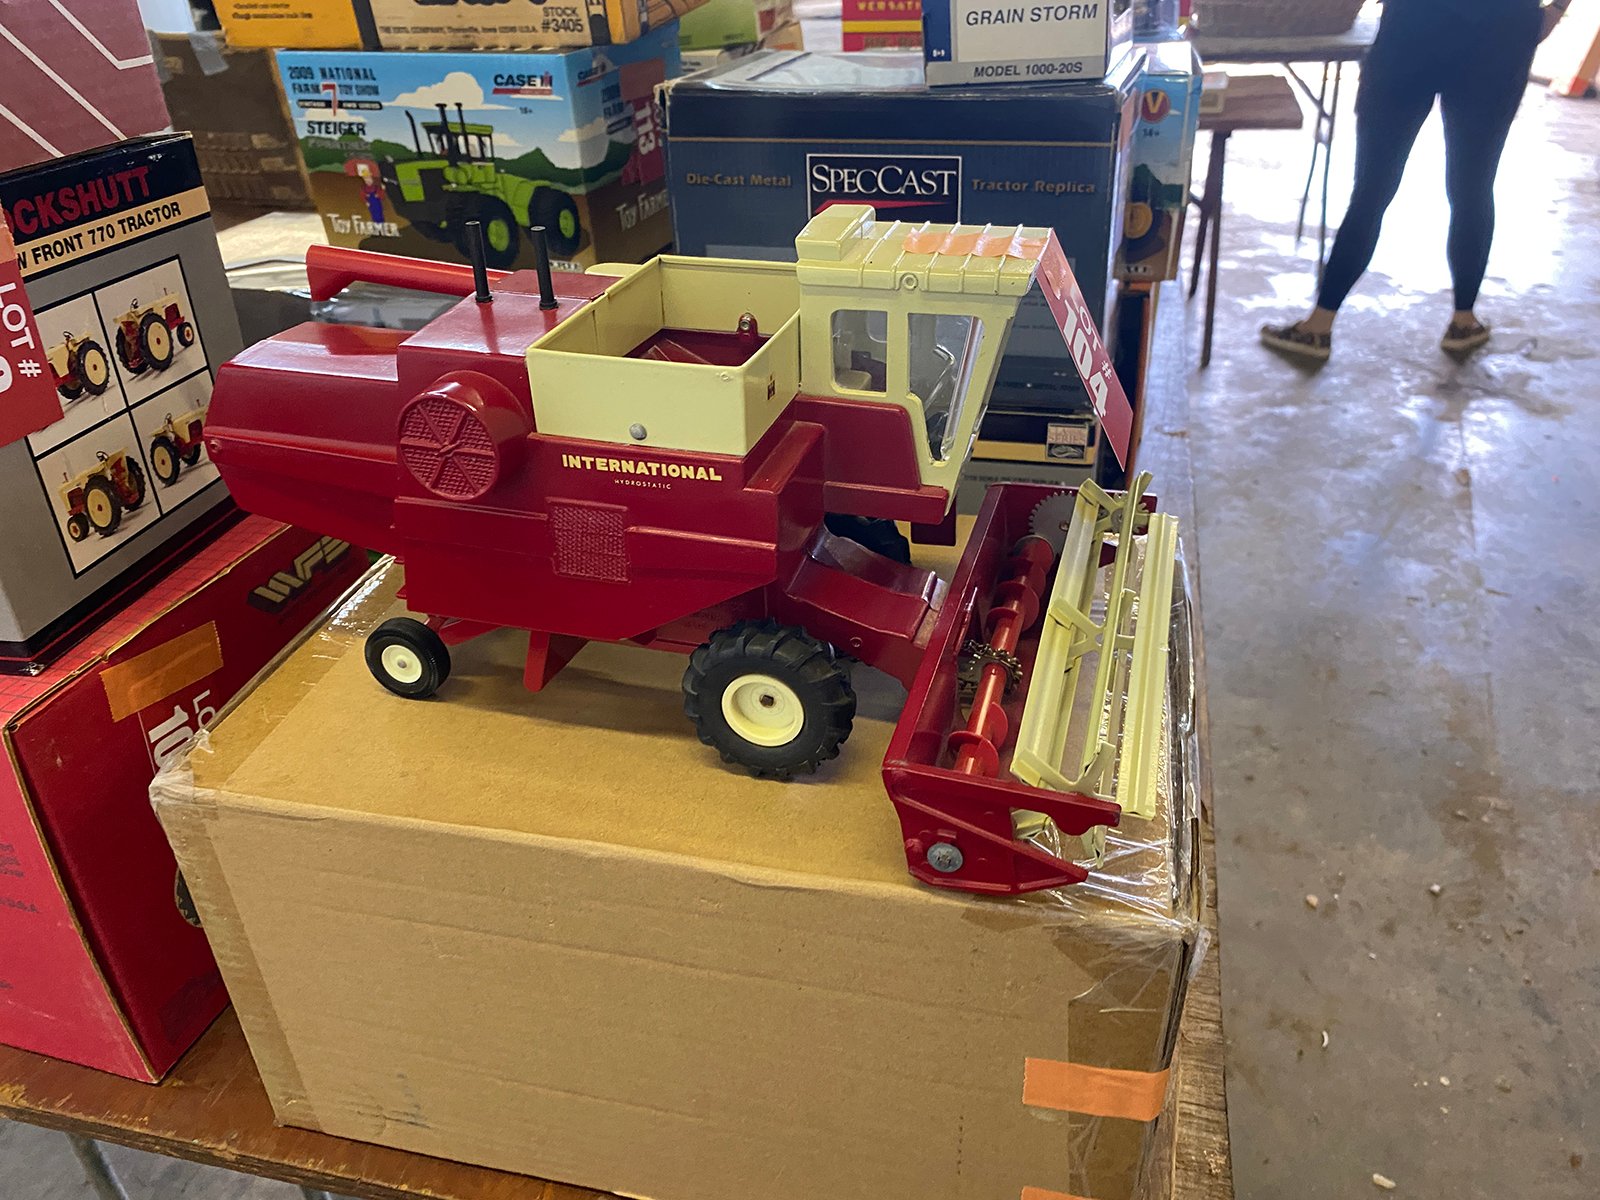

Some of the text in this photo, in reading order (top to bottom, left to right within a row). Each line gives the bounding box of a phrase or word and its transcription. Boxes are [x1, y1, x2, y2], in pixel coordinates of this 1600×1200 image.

[542, 7, 578, 17] STOCK
[966, 3, 1098, 26] GRAIN STORM
[541, 19, 584, 33] #3405
[288, 66, 377, 81] 2009 NATIONAL
[973, 62, 1083, 77] MODEL 1000-20S
[307, 120, 367, 136] STEIGER
[686, 173, 792, 187] Die-Cast Metal
[972, 179, 1096, 196] Tractor Replica
[31, 233, 84, 265] FRONT
[88, 224, 116, 246] 770
[117, 201, 182, 234] TRACTOR
[1063, 300, 1109, 418] 104
[561, 454, 723, 482] INTERNATIONAL
[614, 479, 672, 490] HYDROSTATIC
